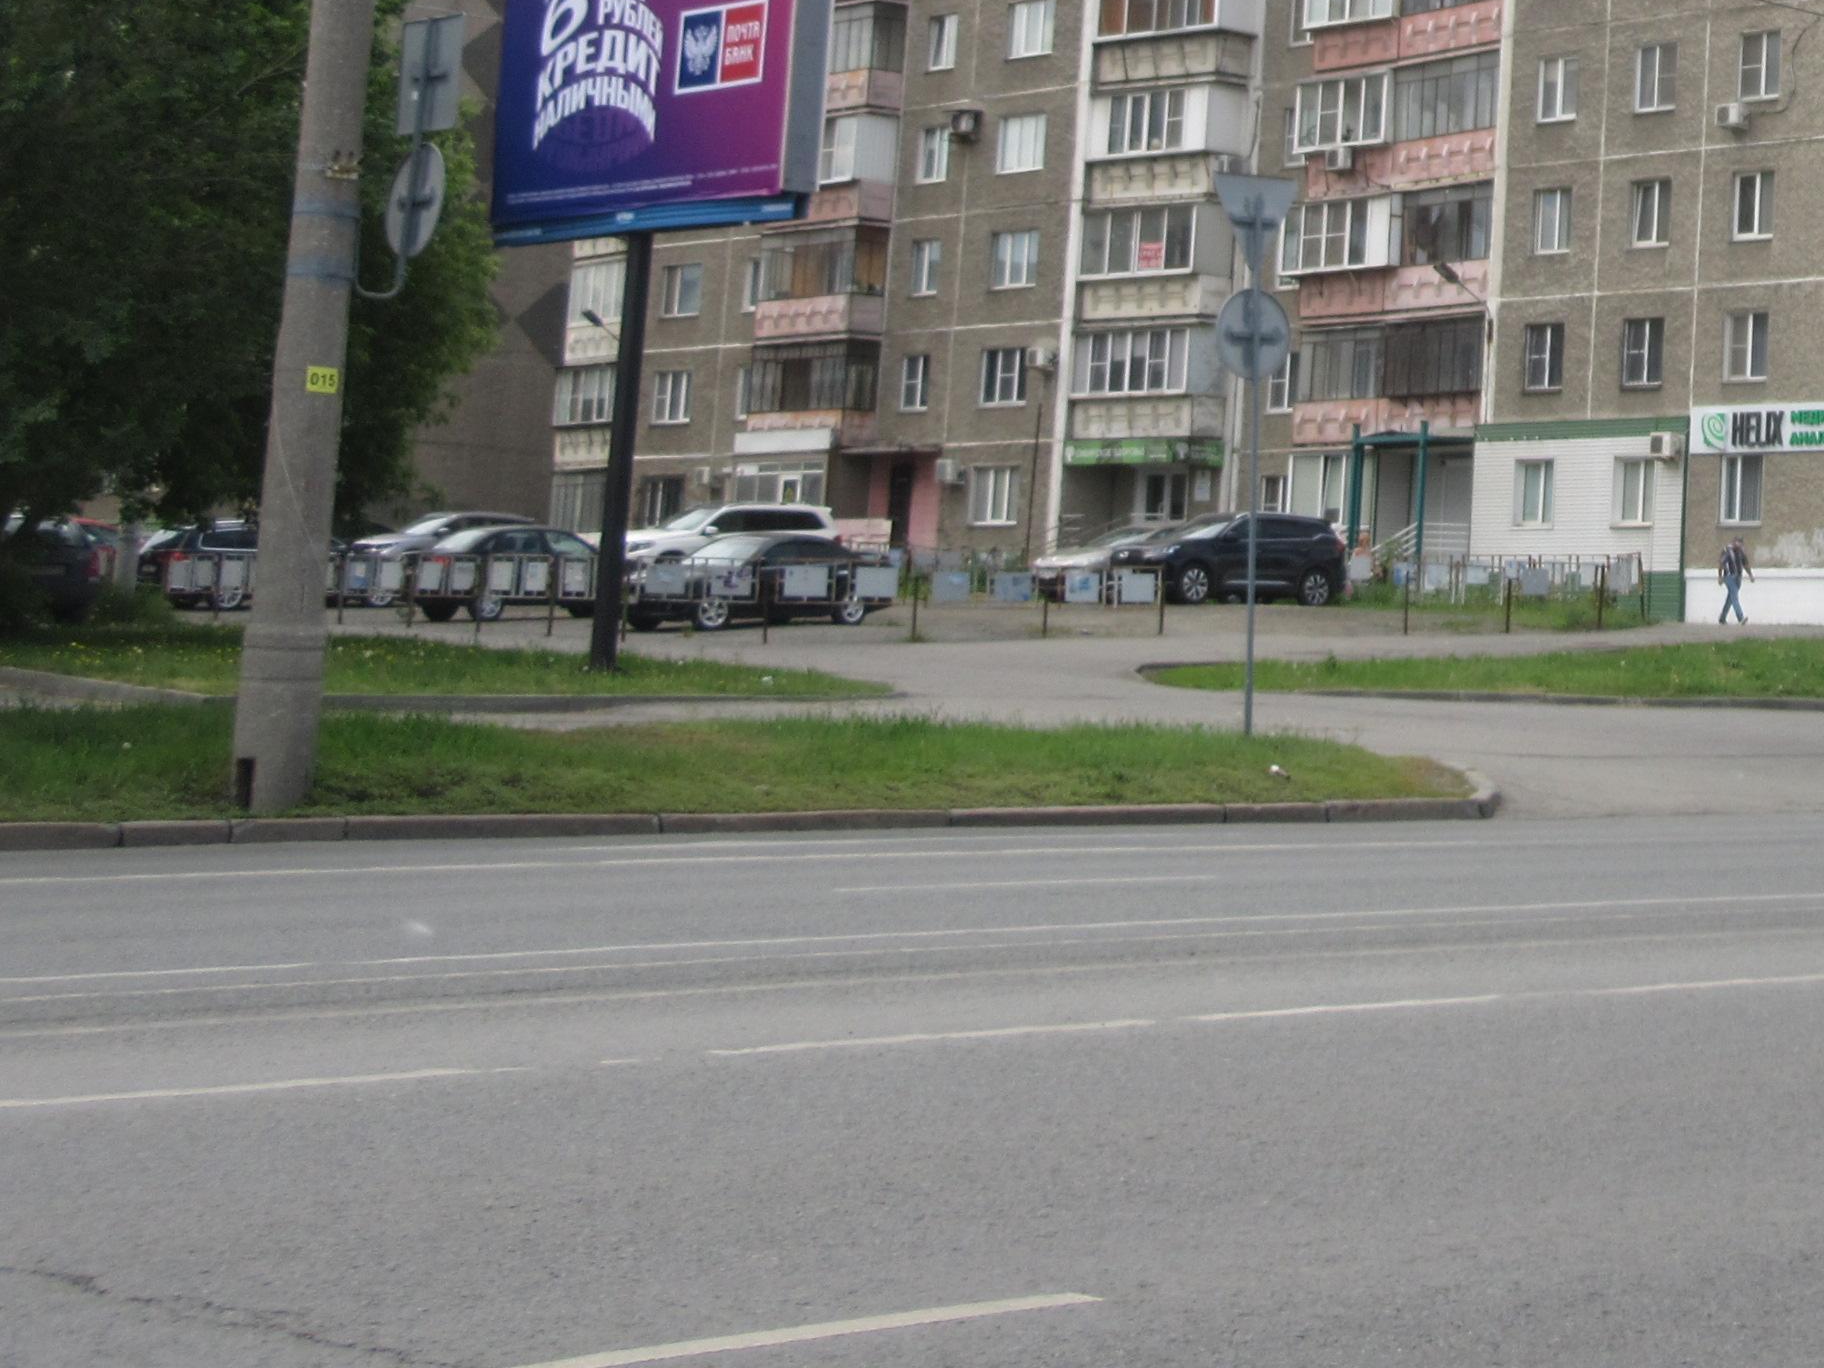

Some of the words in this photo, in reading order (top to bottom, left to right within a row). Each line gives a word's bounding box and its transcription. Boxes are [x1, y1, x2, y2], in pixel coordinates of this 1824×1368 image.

[537, 29, 660, 113] КРЕДИТ
[724, 44, 754, 65] БАНК
[532, 76, 656, 151] НАЛИЧНЫМИ
[310, 372, 337, 387] 015
[1731, 410, 1784, 448] HELIX
